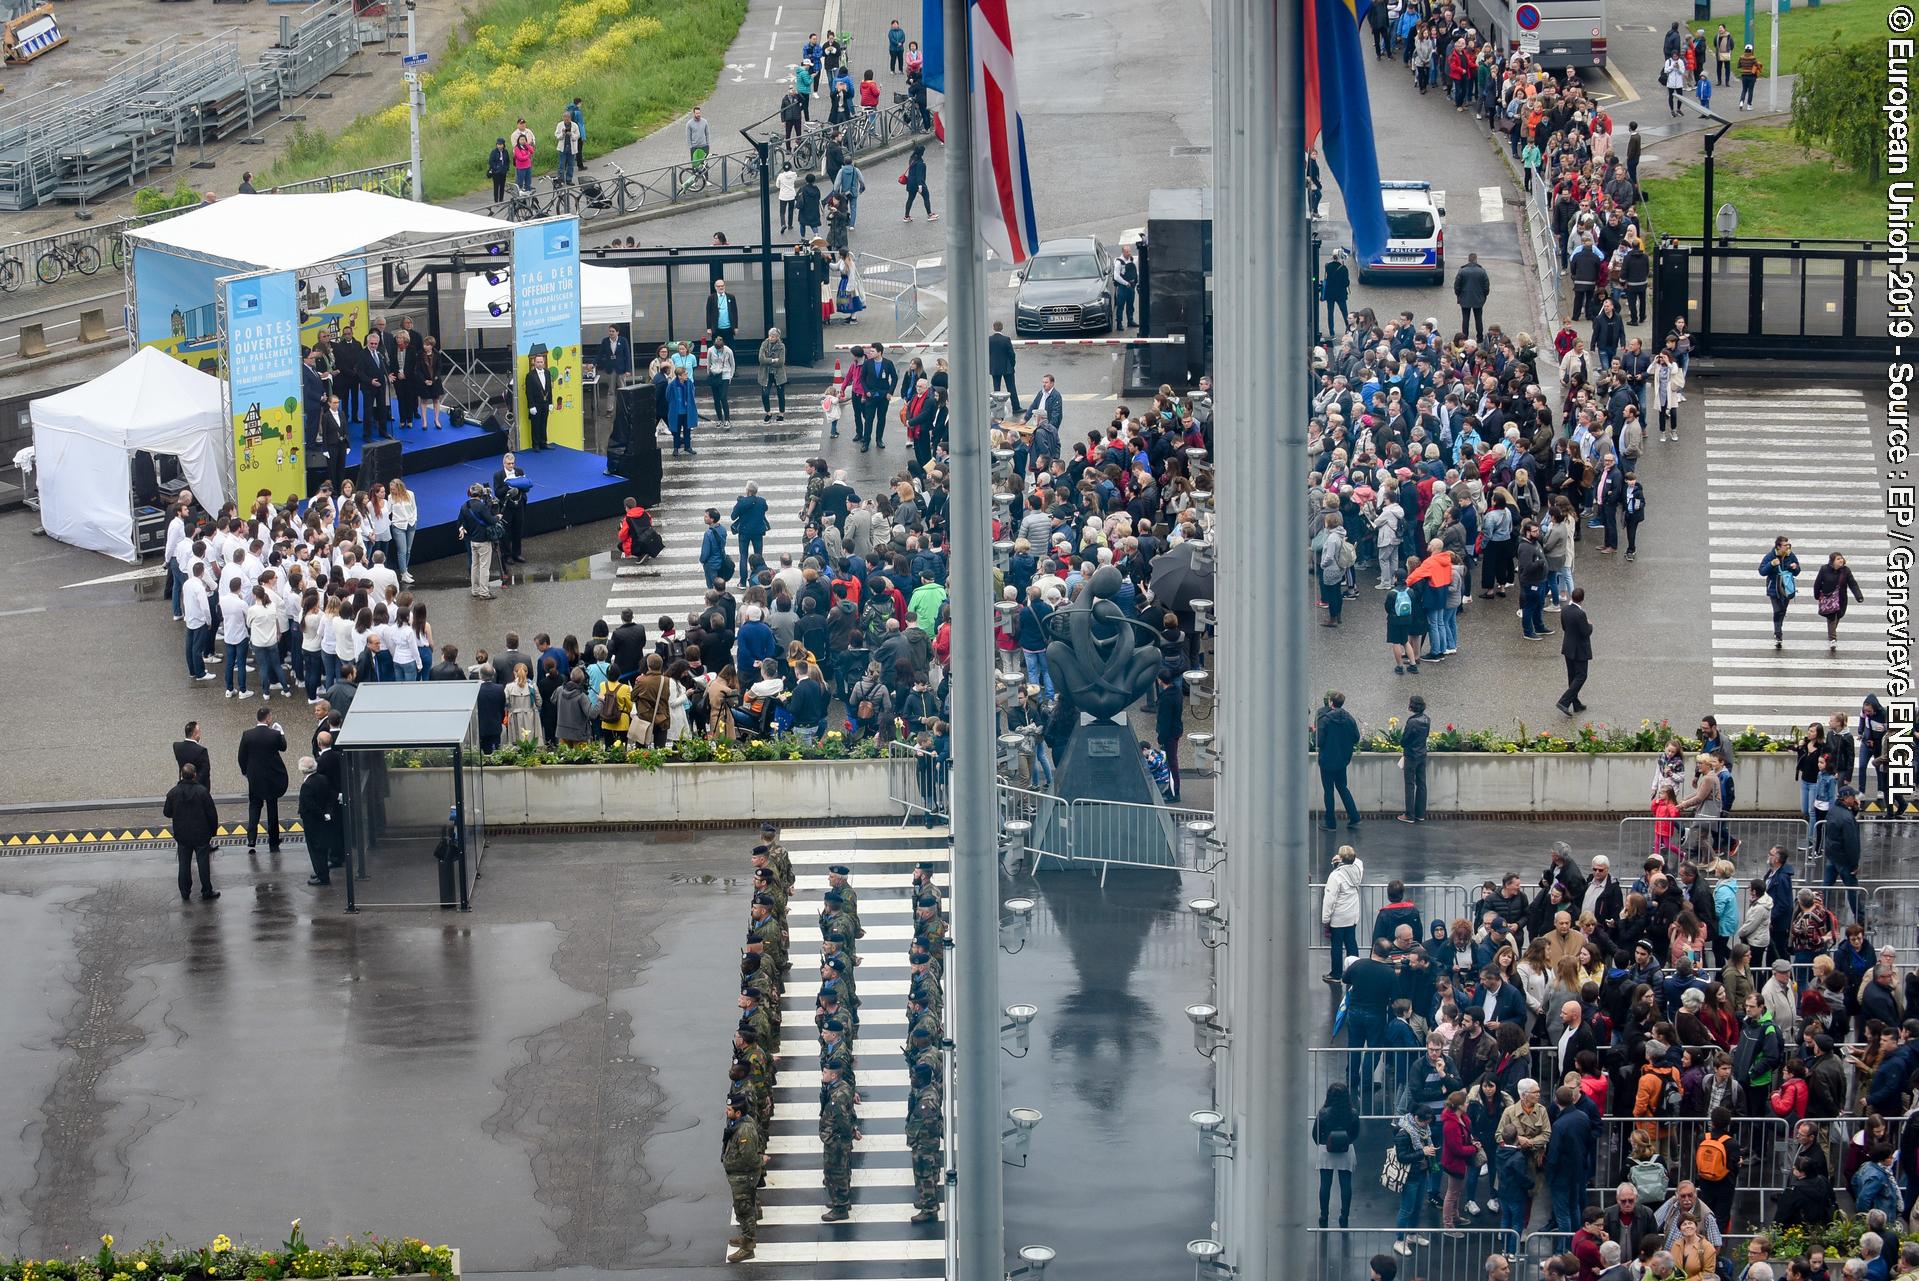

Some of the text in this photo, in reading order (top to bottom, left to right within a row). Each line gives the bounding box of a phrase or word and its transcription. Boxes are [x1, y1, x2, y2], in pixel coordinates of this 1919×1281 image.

[521, 266, 573, 285] TAG DER
[522, 282, 556, 298] OFFENEN
[234, 320, 292, 342] PORTES
[235, 334, 293, 355] OUVERTES
[236, 347, 293, 365] DU PARLEMENT
[236, 357, 293, 375] EUROPÉEN
